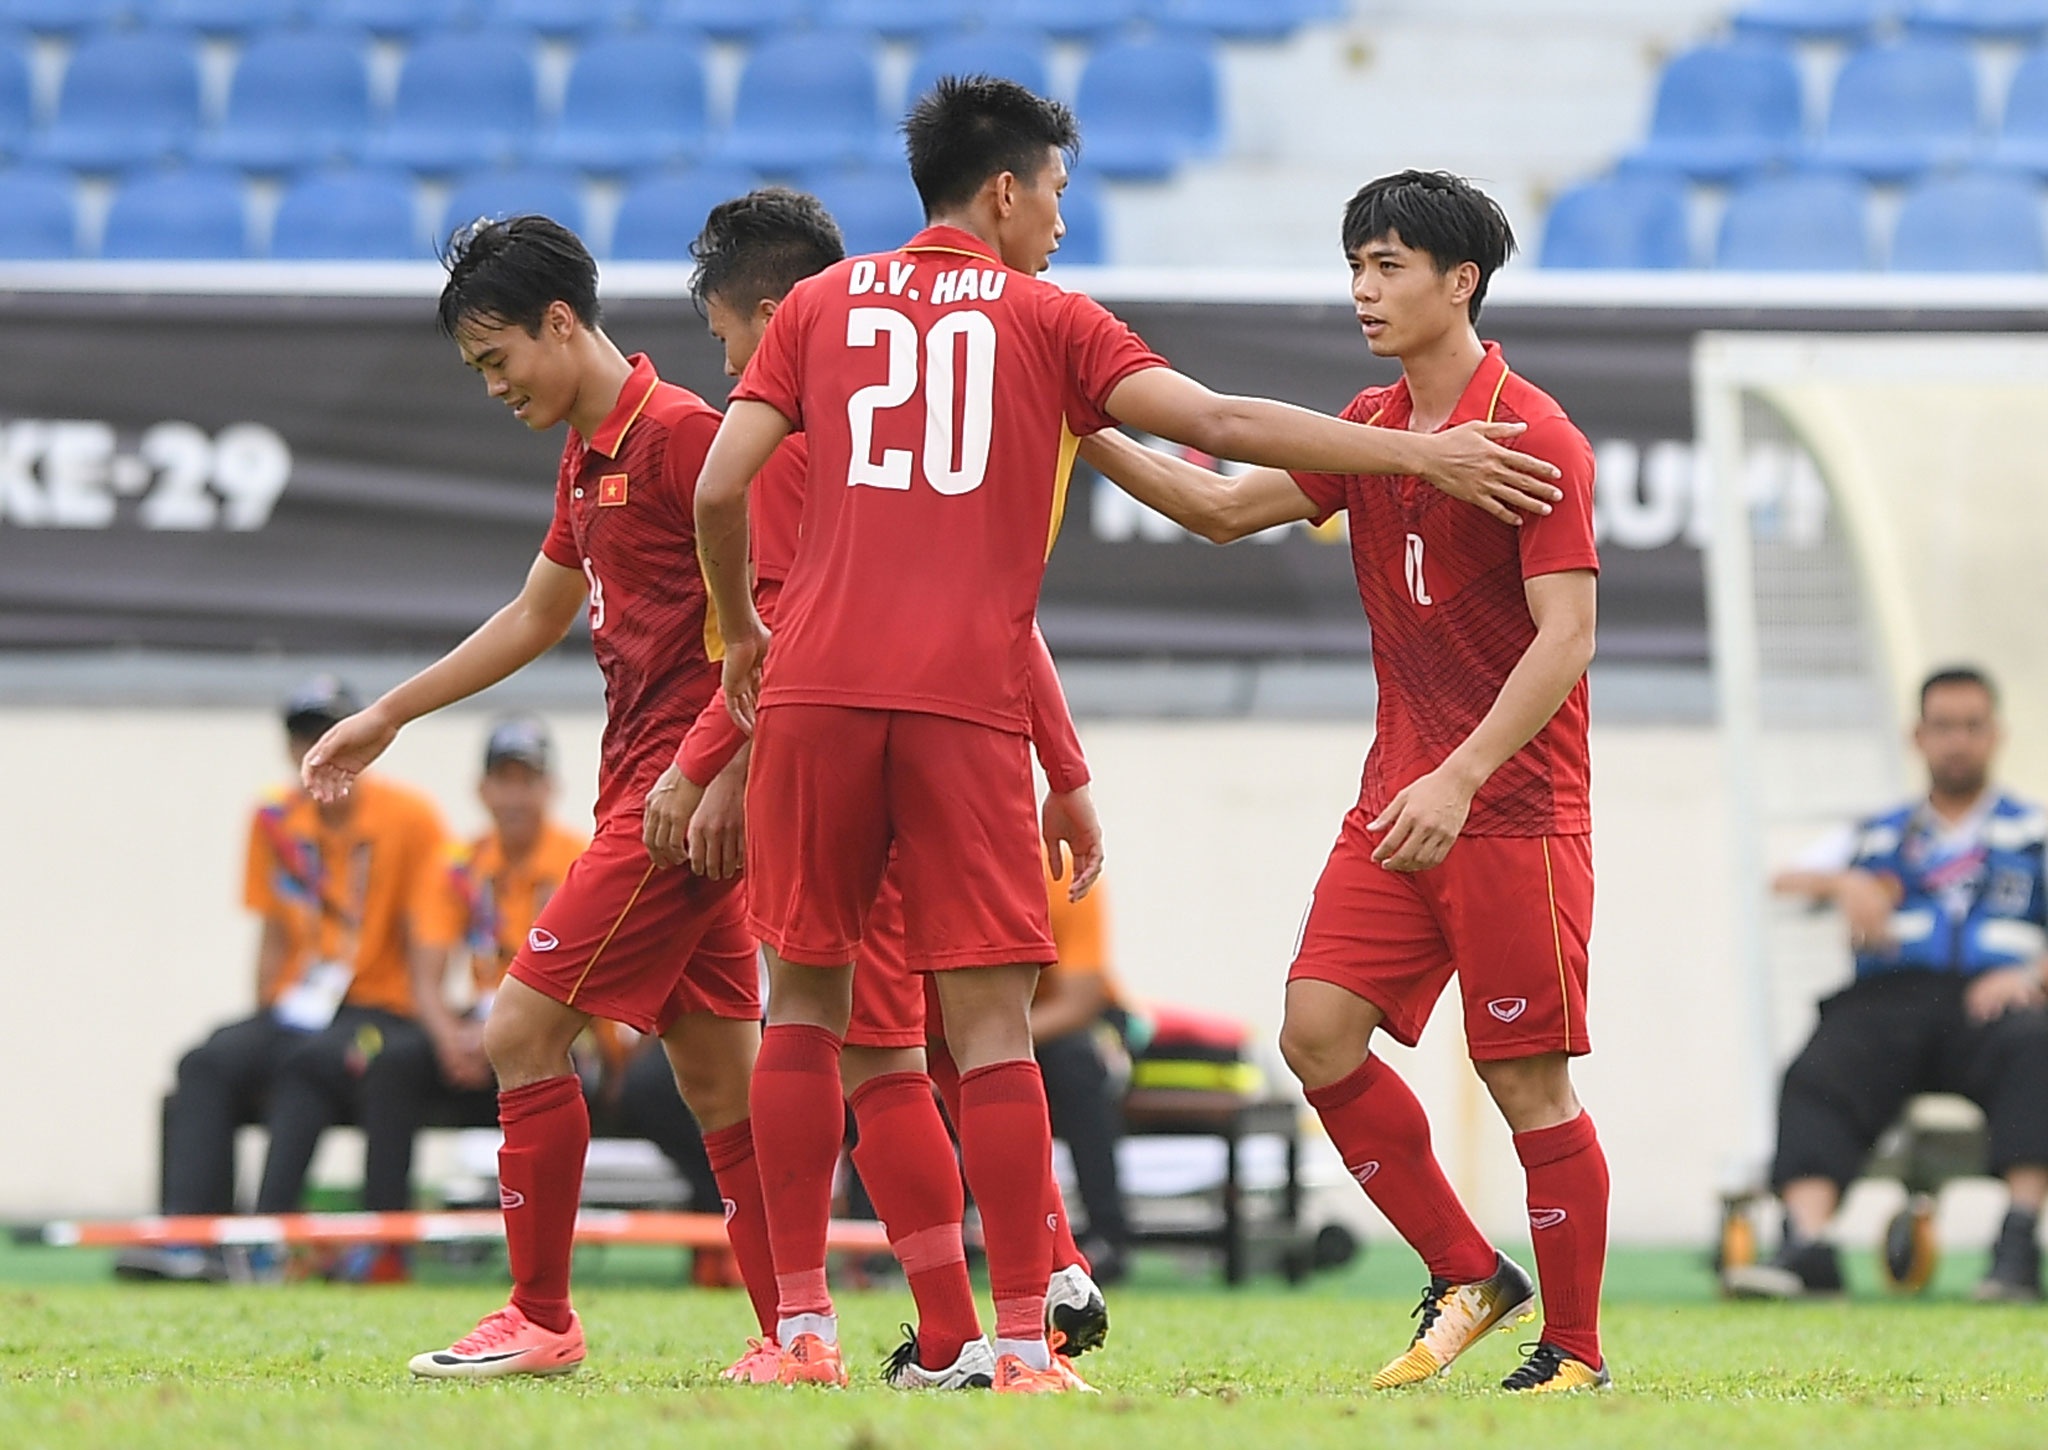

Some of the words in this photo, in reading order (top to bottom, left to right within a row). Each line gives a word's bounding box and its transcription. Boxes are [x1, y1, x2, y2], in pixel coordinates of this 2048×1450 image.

[849, 261, 920, 301] D.V.
[931, 268, 1007, 304] HAU
[847, 307, 996, 495] 20
